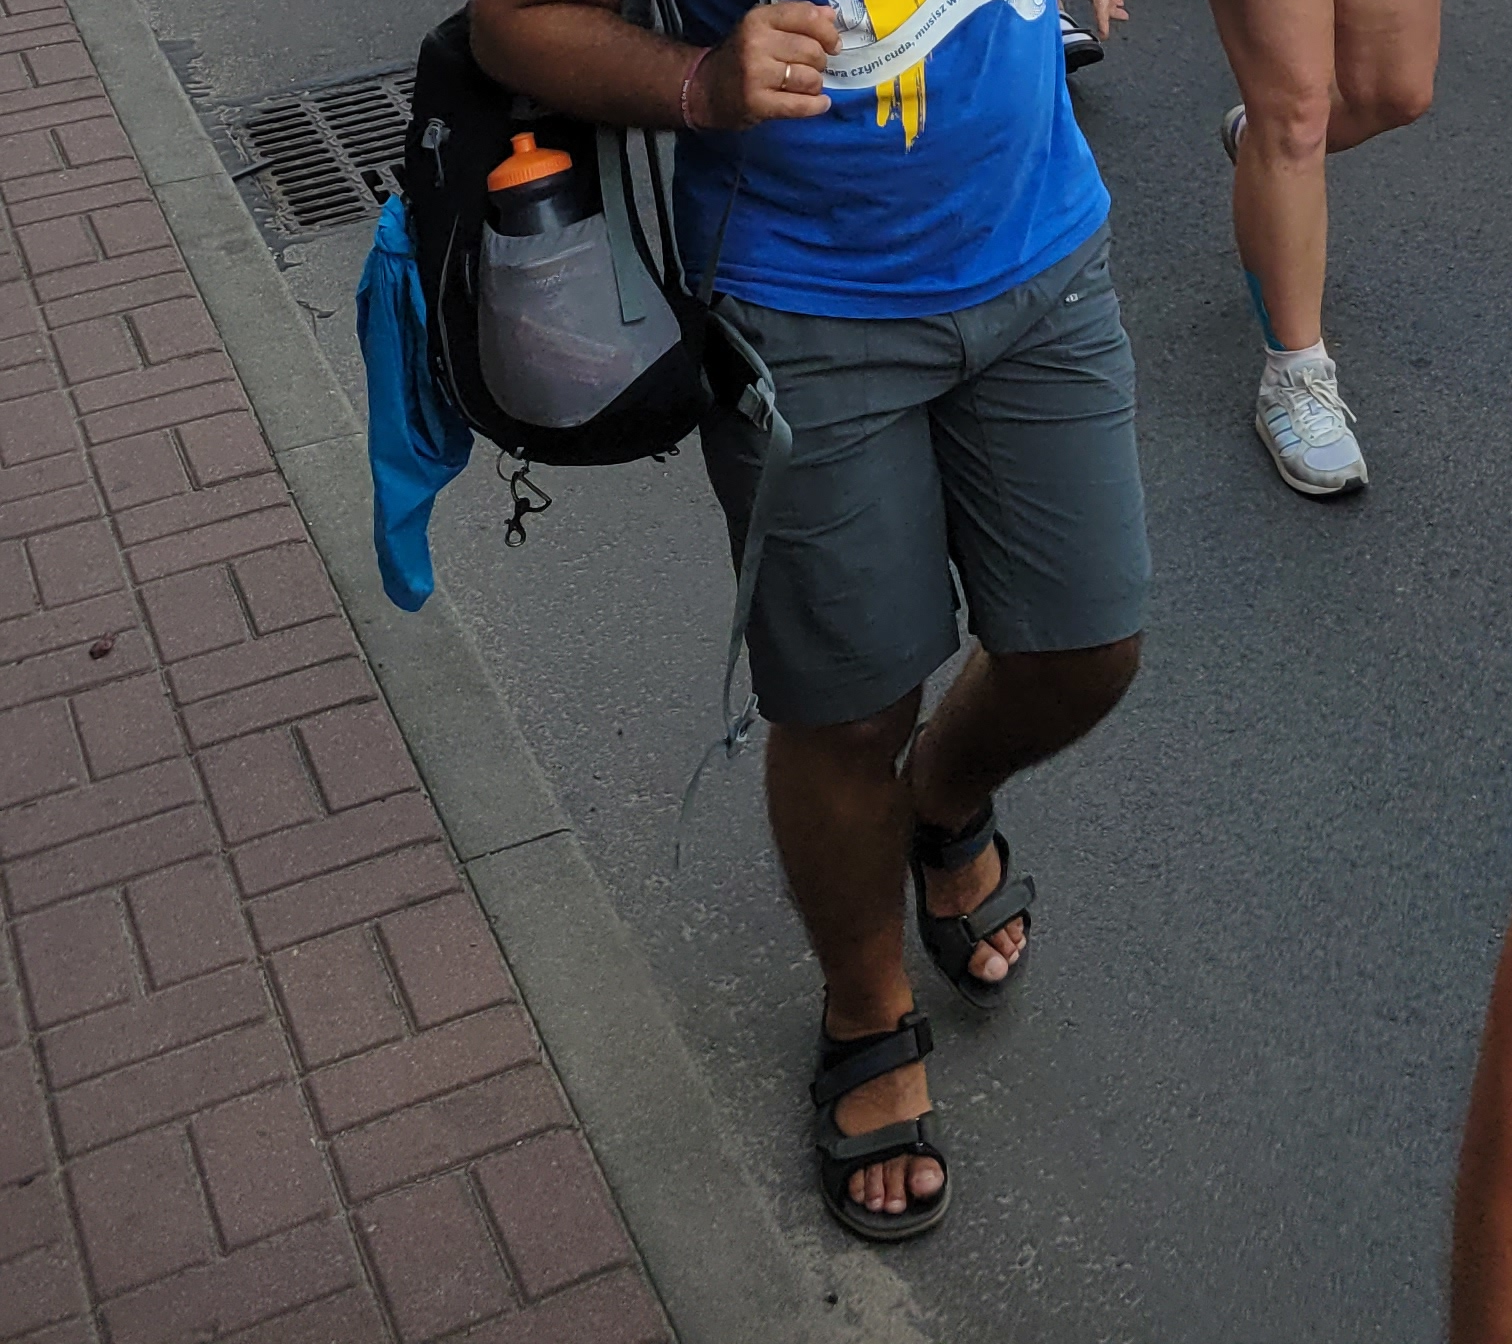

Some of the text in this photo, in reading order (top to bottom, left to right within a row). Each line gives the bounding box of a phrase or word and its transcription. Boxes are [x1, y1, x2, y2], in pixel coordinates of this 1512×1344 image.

[823, 65, 848, 78] iara
[850, 57, 883, 77] czyni
[884, 40, 916, 63] cuda,
[914, 5, 947, 41] musisz
